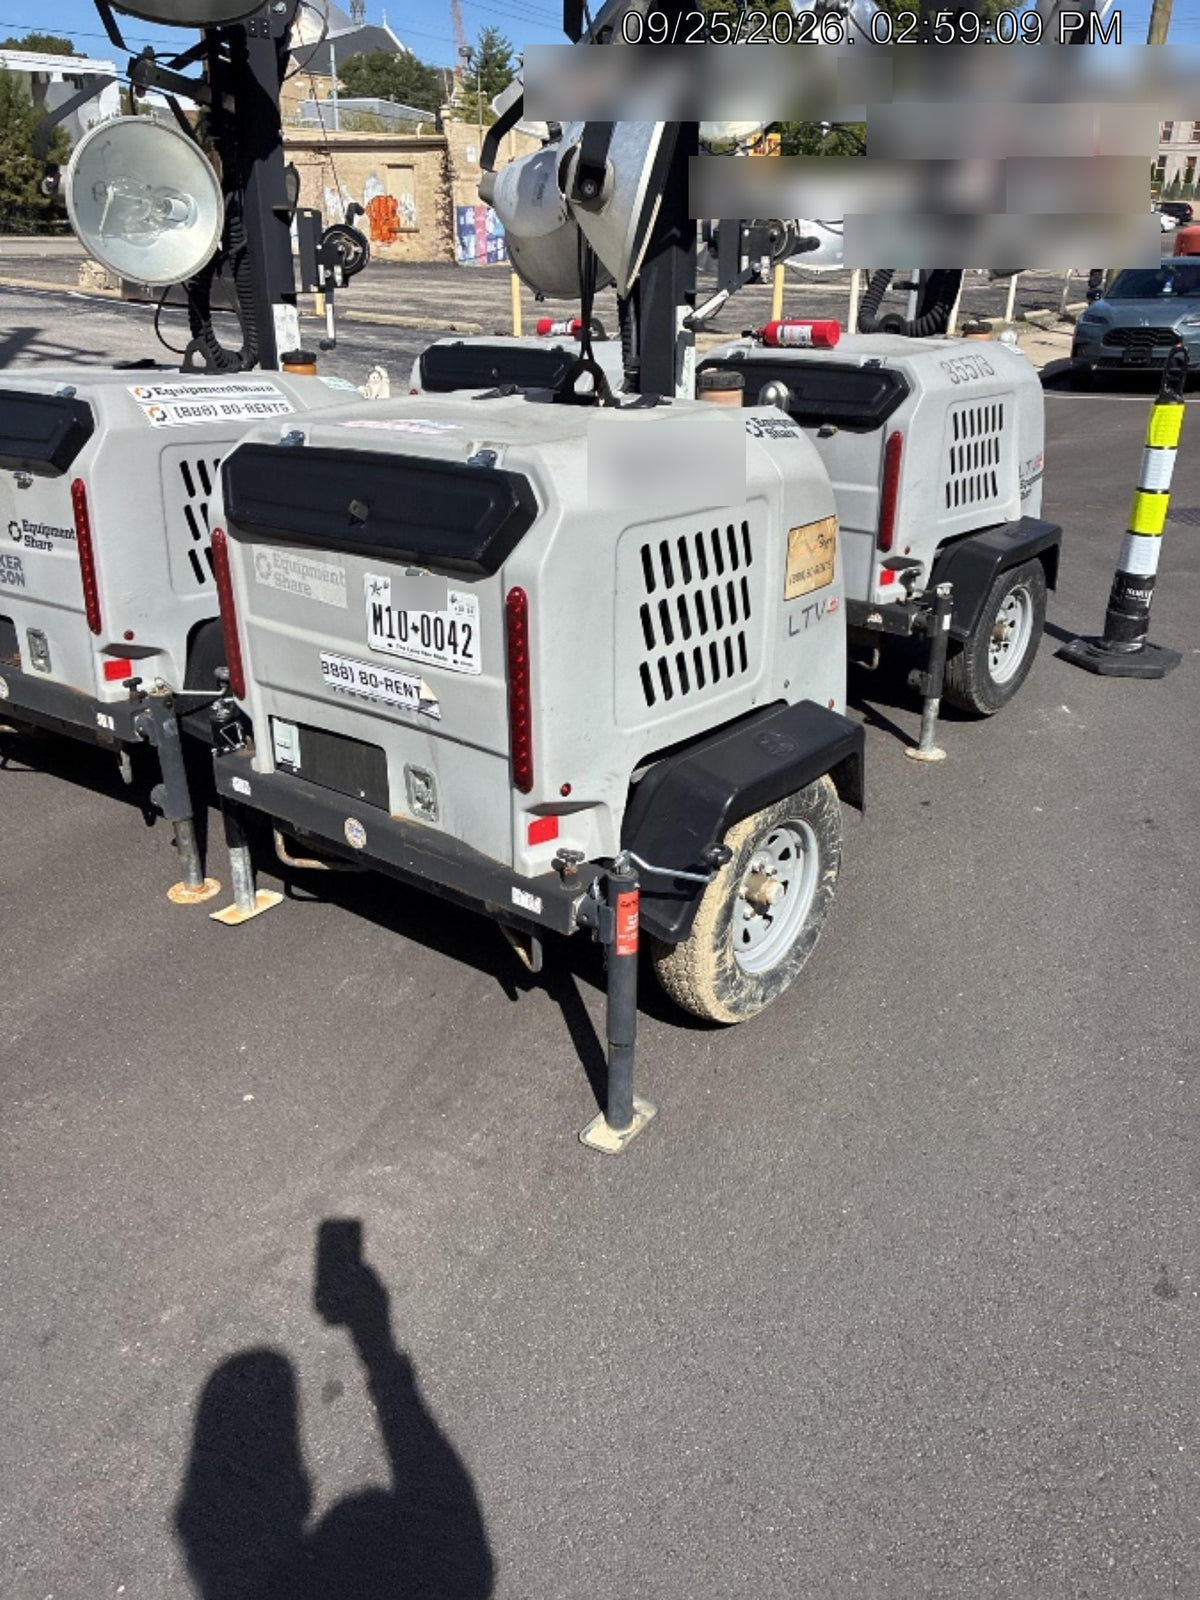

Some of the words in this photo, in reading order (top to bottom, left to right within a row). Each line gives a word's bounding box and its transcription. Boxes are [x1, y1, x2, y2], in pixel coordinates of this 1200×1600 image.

[940, 354, 995, 384] 35573
[152, 385, 275, 397] EquipmentShare
[21, 519, 76, 540] Equipment
[24, 534, 54, 551] Share
